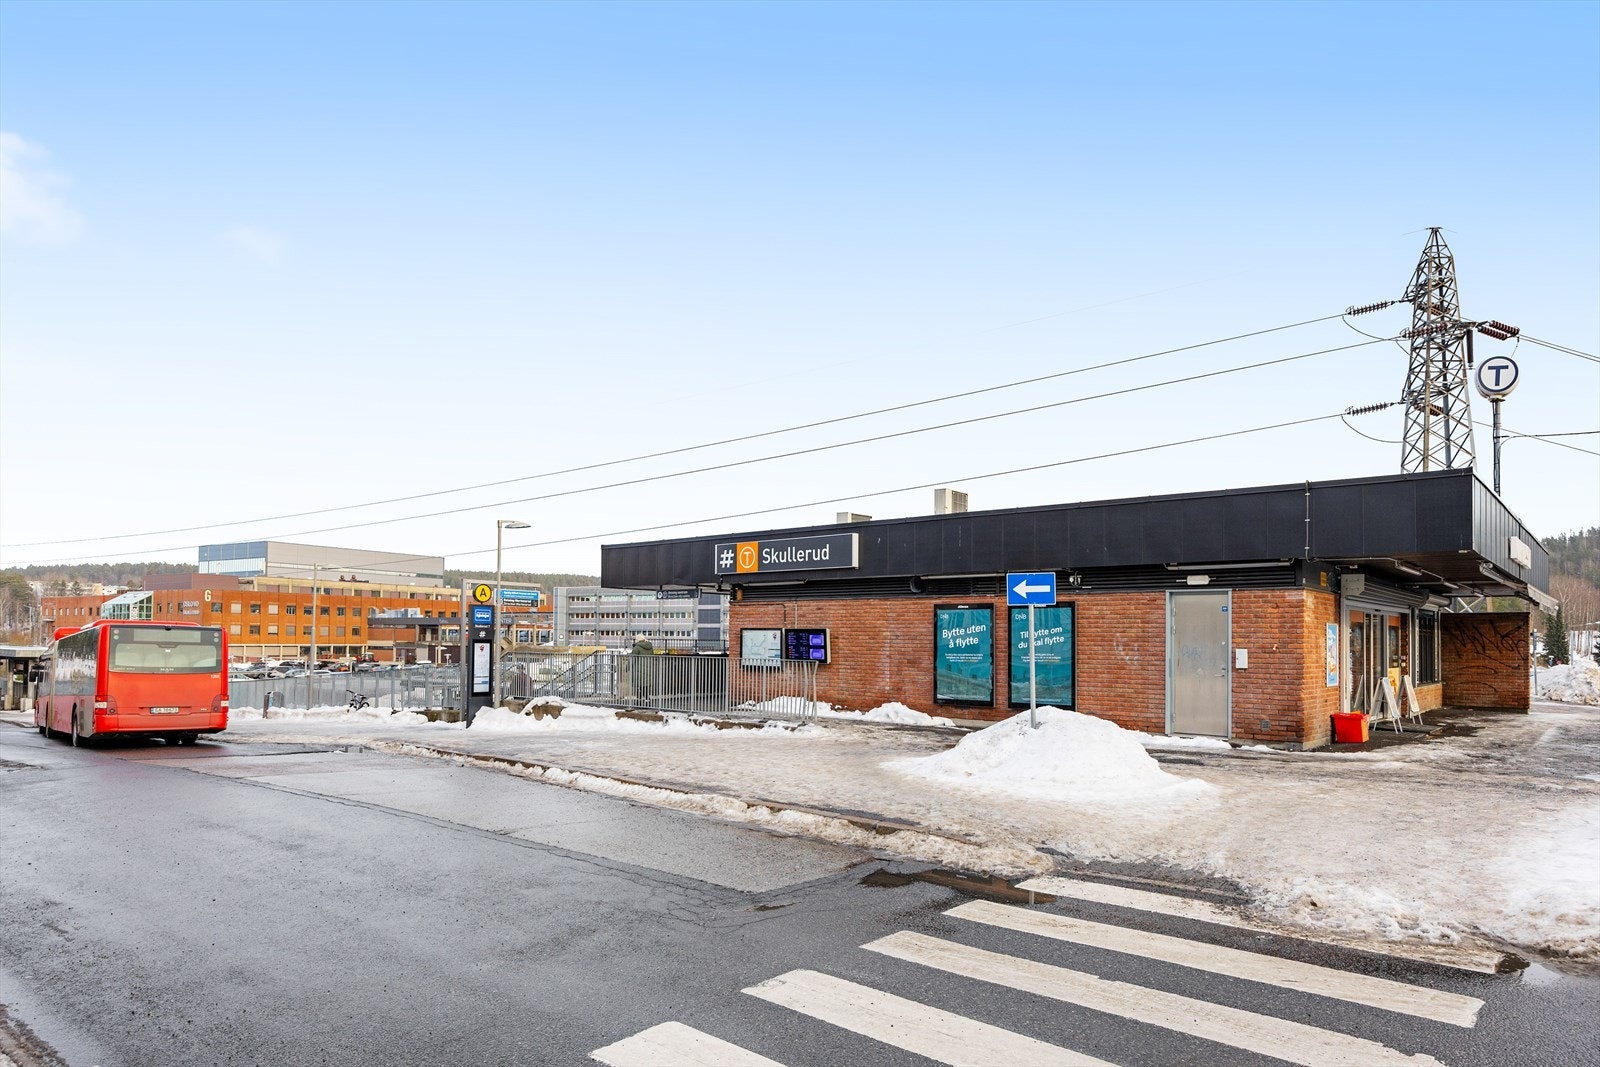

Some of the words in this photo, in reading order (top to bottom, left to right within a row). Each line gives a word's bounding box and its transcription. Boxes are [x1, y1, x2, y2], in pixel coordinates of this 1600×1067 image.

[1488, 365, 1509, 387] T
[762, 543, 830, 564] Skullerud
[479, 587, 487, 598] A
[942, 627, 965, 639] Bytte
[966, 624, 986, 634] uten
[1020, 631, 1029, 639] Til
[1032, 629, 1049, 639] ytte
[948, 639, 954, 648] å
[956, 637, 979, 649] flytte
[1018, 641, 1028, 649] du
[1032, 639, 1043, 647] kal
[1044, 636, 1065, 646] flytte
